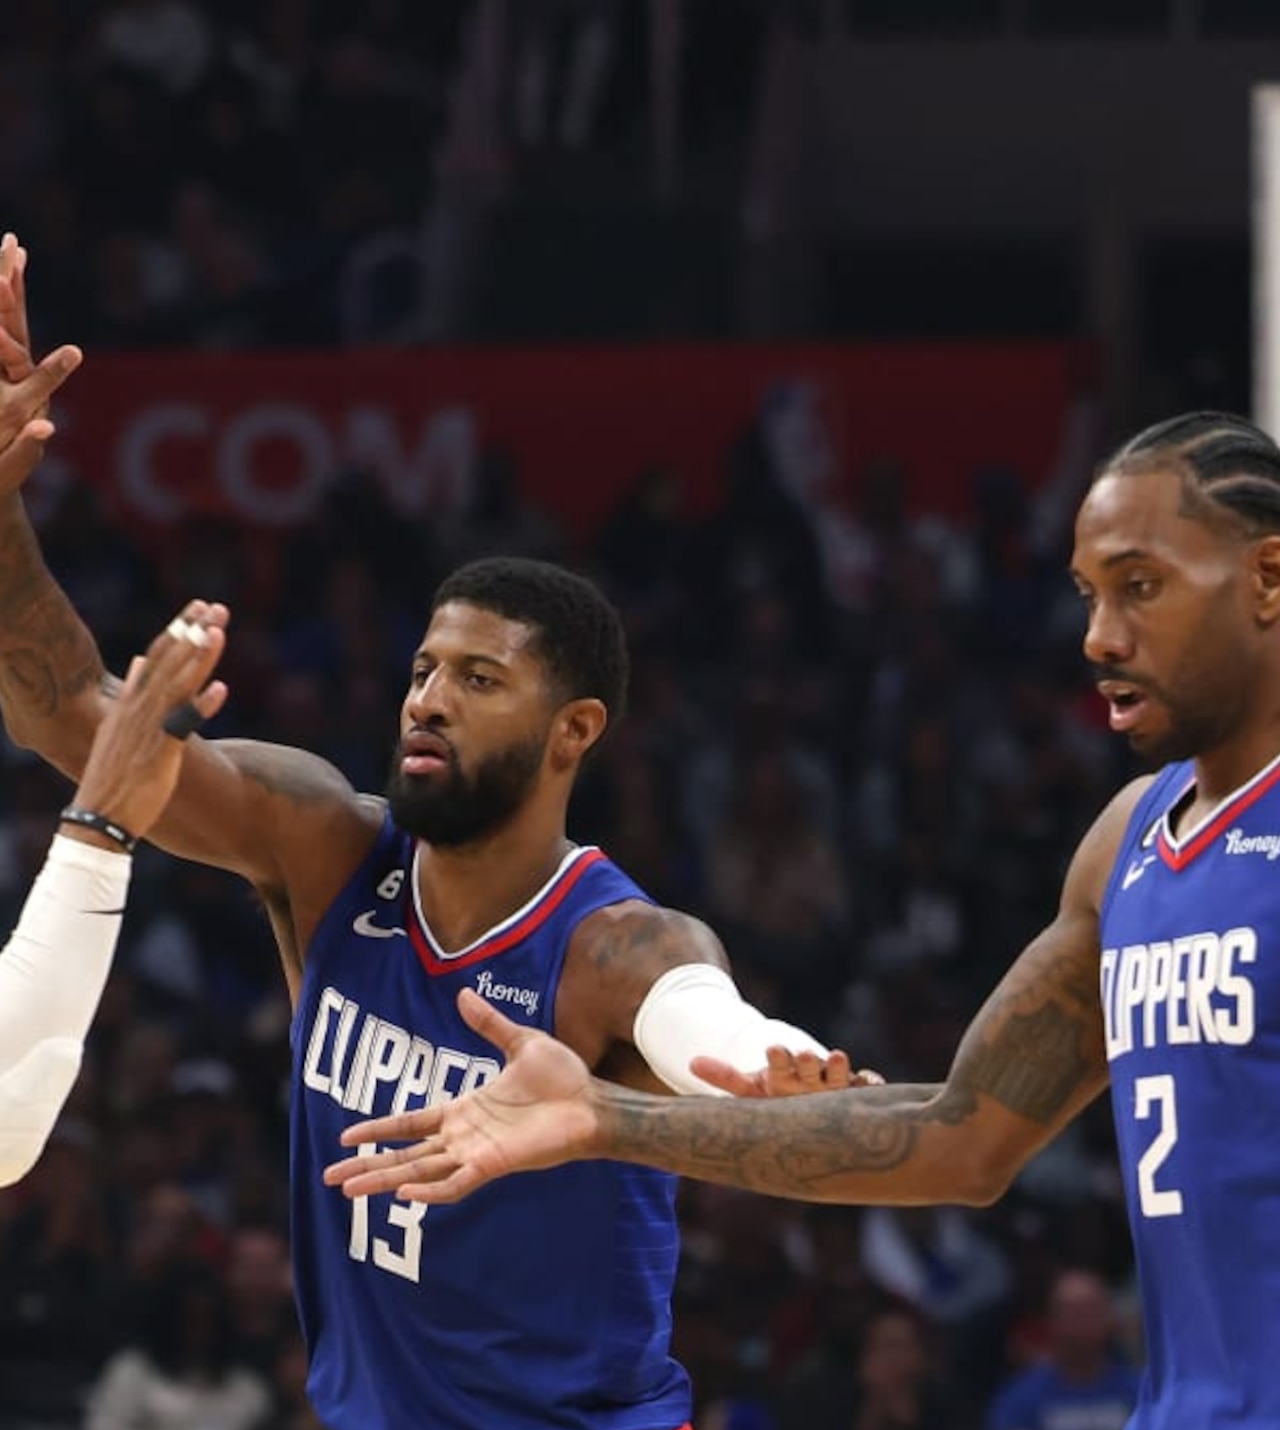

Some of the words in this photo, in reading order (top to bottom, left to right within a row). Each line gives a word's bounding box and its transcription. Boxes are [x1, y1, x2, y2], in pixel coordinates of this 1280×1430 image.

[376, 869, 405, 900] 6
[303, 986, 501, 1116] CLIPPE
[349, 1142, 428, 1283] 13
[1134, 1074, 1183, 1218] 2
